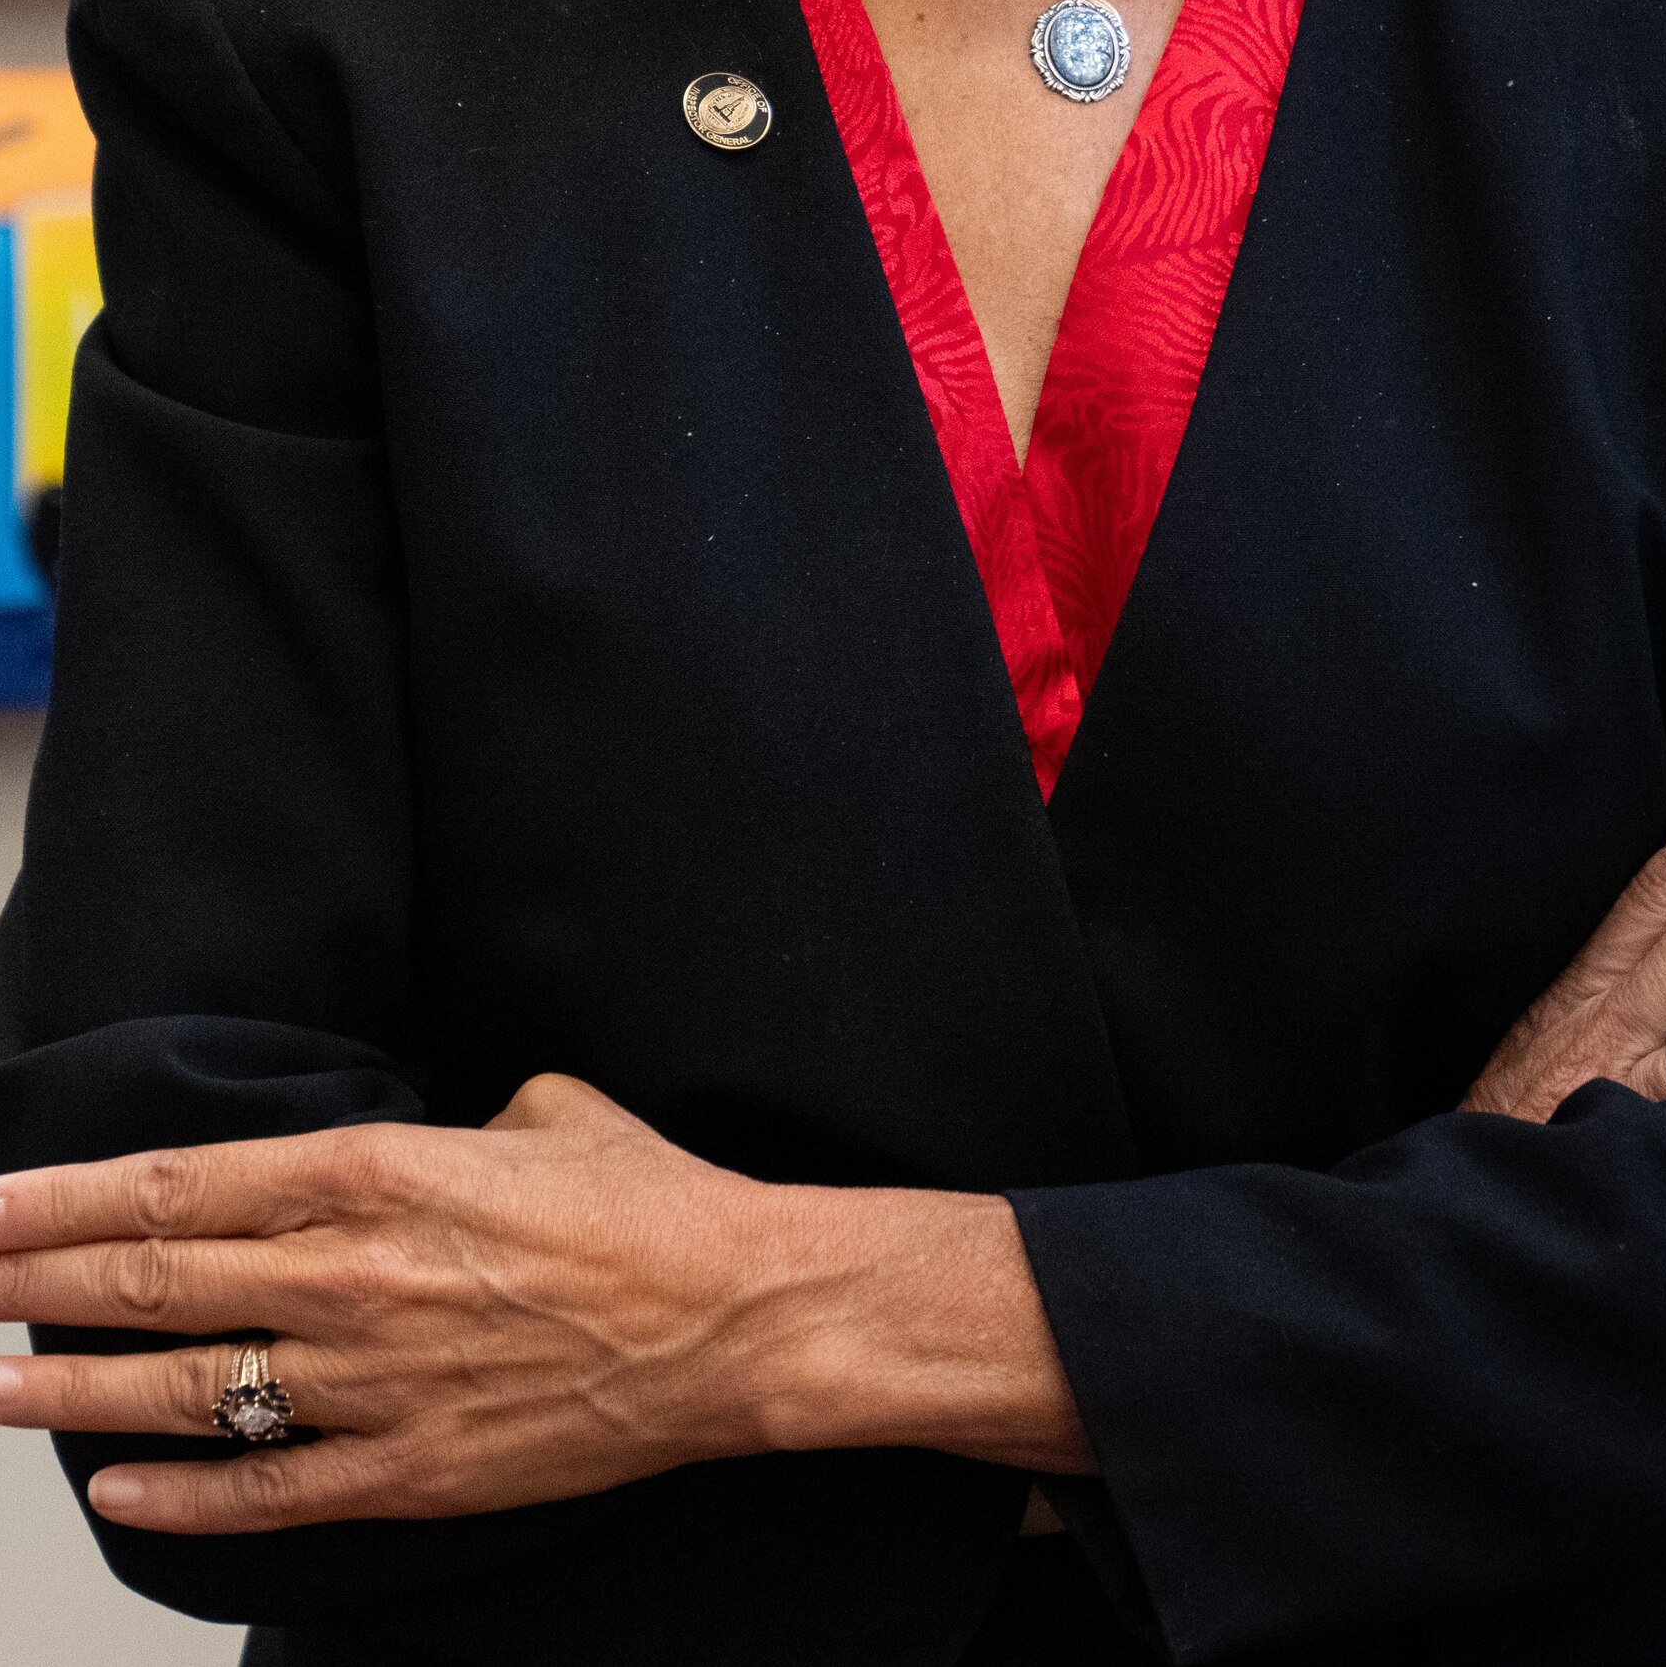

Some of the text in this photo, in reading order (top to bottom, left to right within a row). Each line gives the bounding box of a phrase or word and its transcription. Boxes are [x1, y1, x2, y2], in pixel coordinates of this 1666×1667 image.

[686, 86, 708, 134] INSPECTOR
[706, 132, 752, 146] GENERAL
[727, 76, 761, 101] OFFICE
[756, 100, 768, 113] OF
